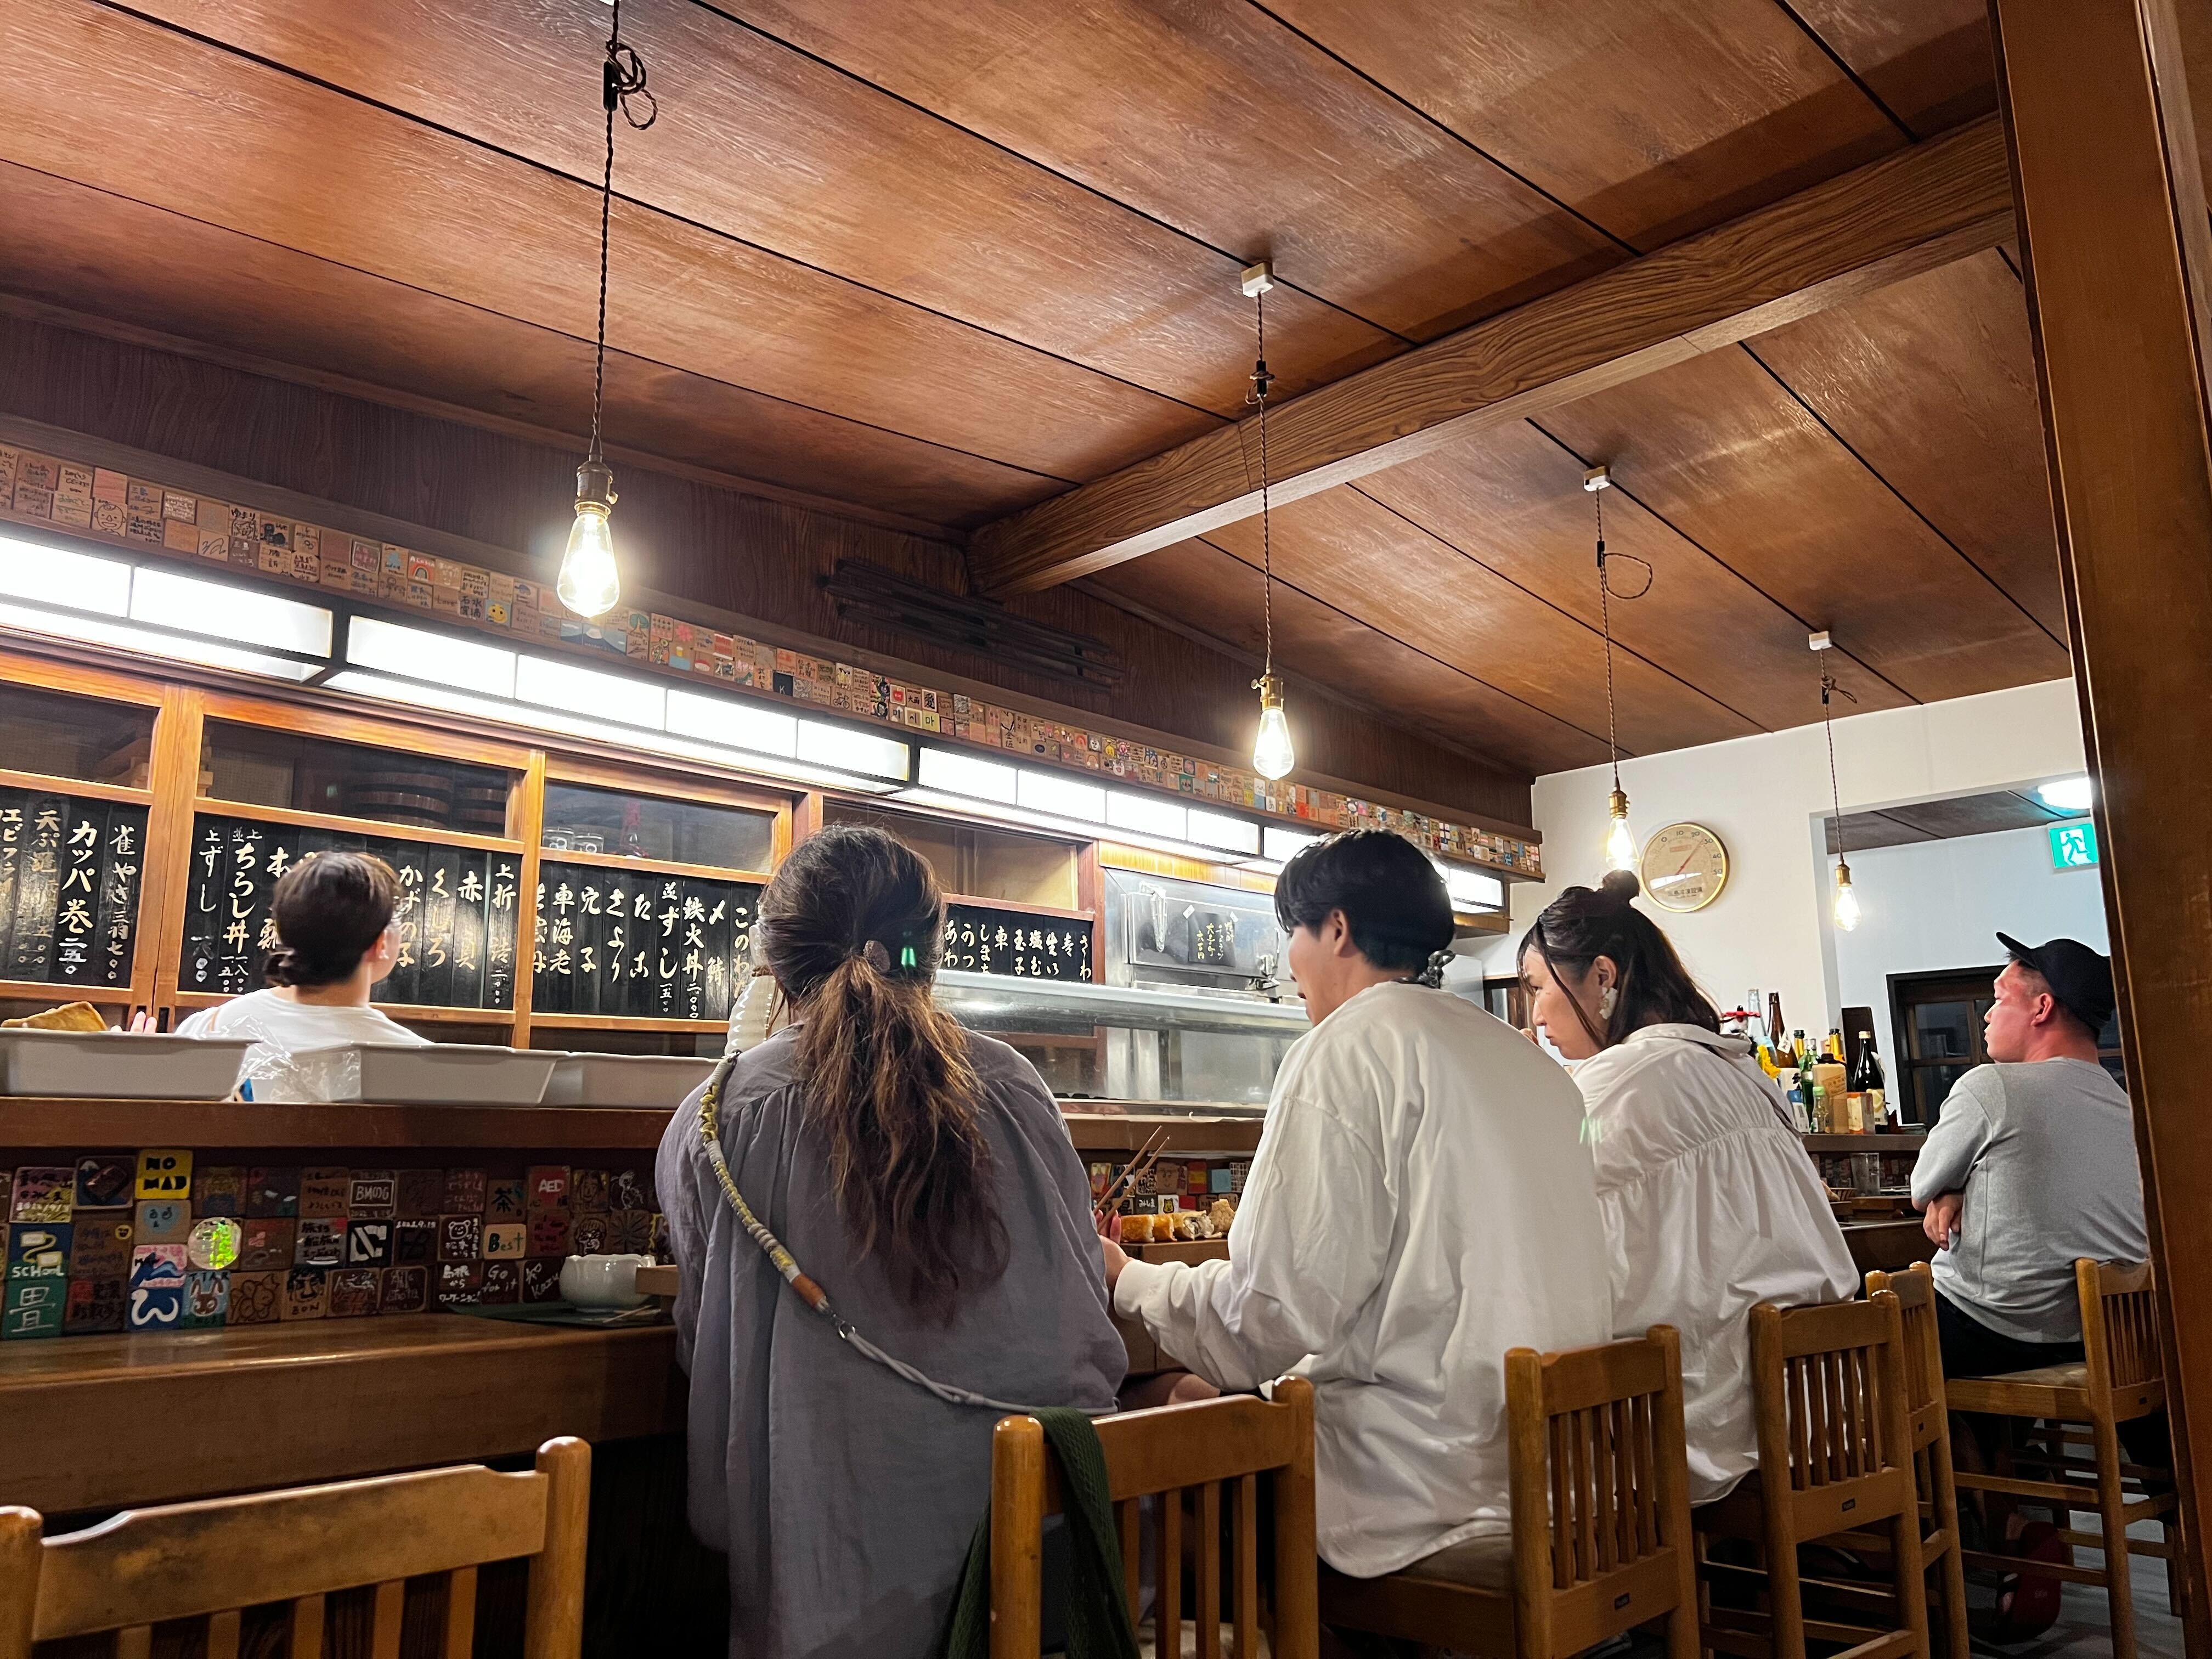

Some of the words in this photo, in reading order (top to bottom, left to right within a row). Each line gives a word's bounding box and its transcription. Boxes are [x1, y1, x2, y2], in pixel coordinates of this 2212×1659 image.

[550, 882, 575, 975] 車海老
[580, 885, 601, 973] 穴子
[538, 1179, 565, 1193] AED
[491, 1187, 515, 1213] 茶
[488, 1232, 524, 1252] Best
[488, 1264, 509, 1279] Go
